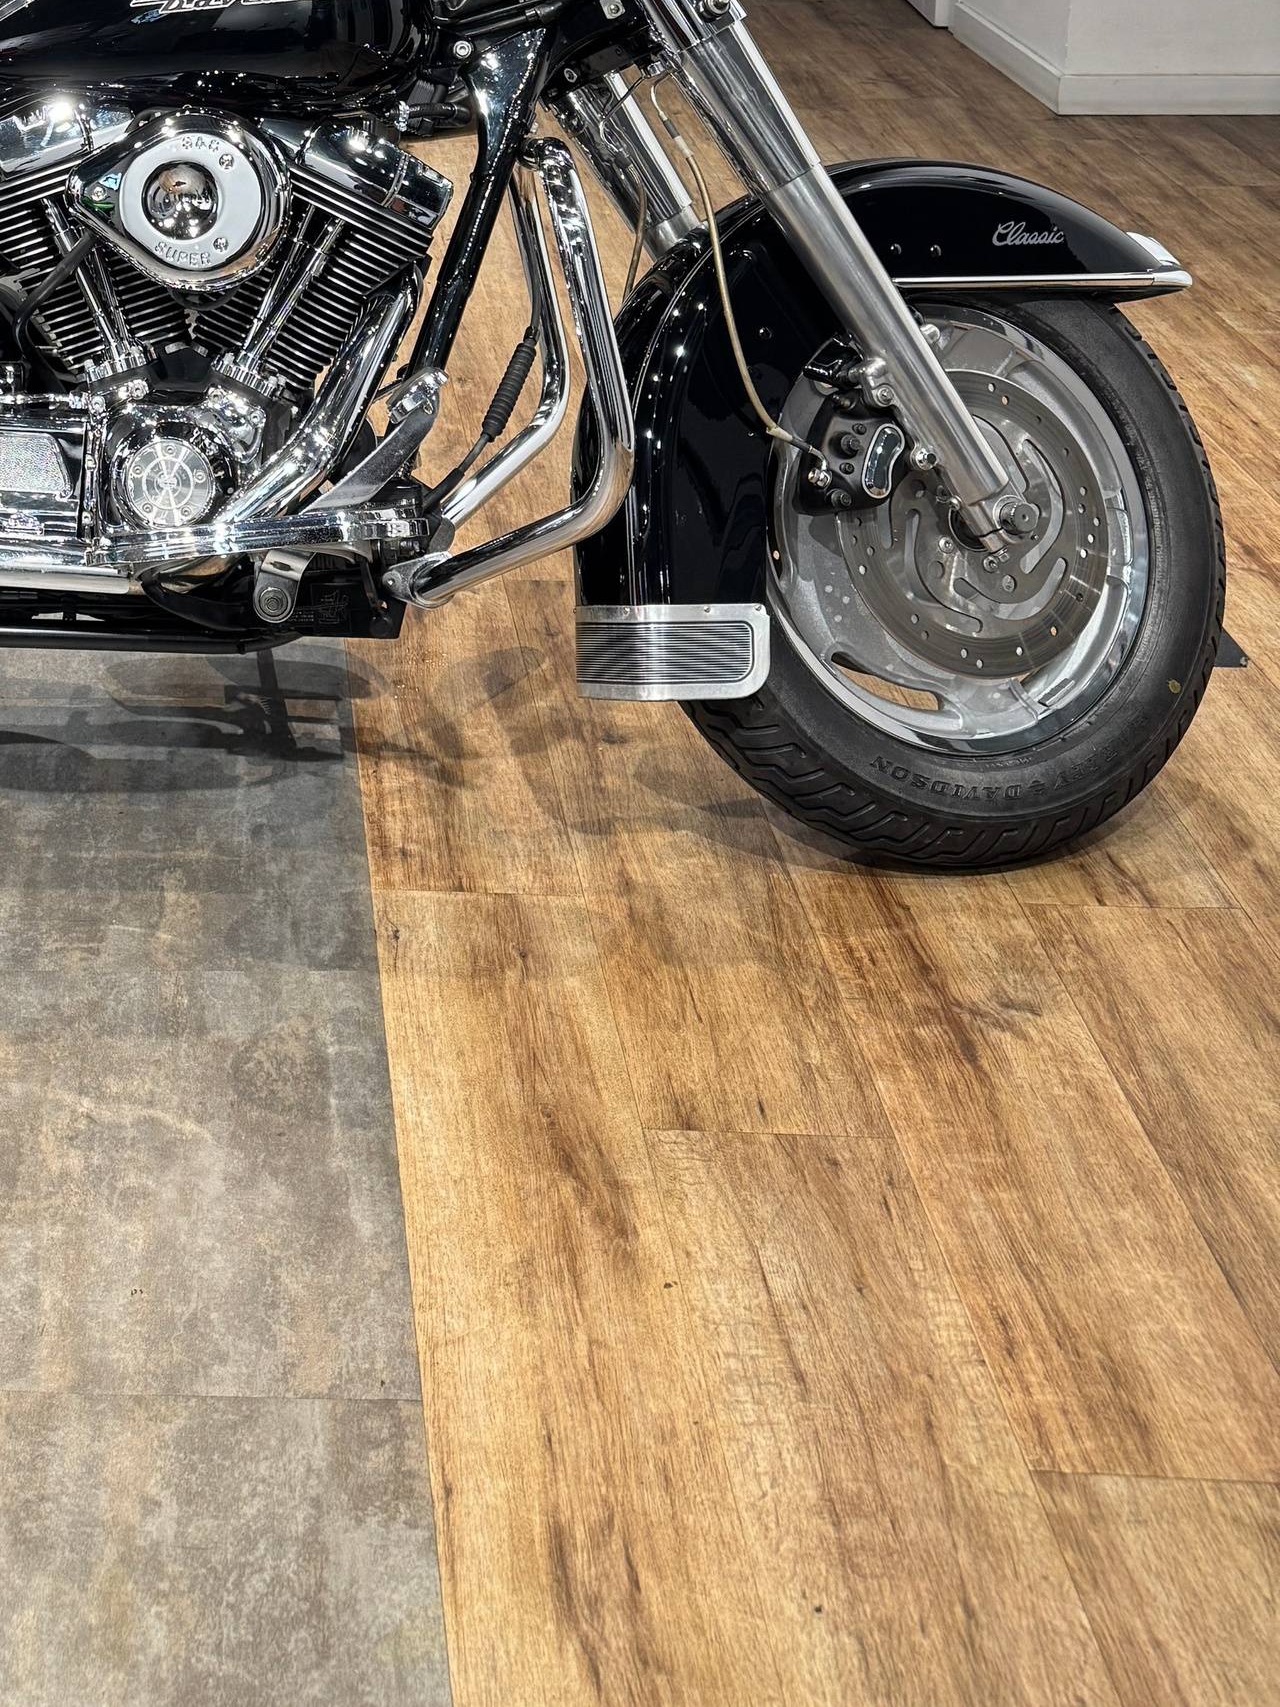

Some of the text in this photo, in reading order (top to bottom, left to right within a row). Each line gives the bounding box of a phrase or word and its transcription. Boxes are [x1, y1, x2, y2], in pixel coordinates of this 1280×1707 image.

[992, 220, 1065, 247] Classic
[154, 241, 212, 267] SUPER
[869, 755, 1022, 802] DAVIDSON
